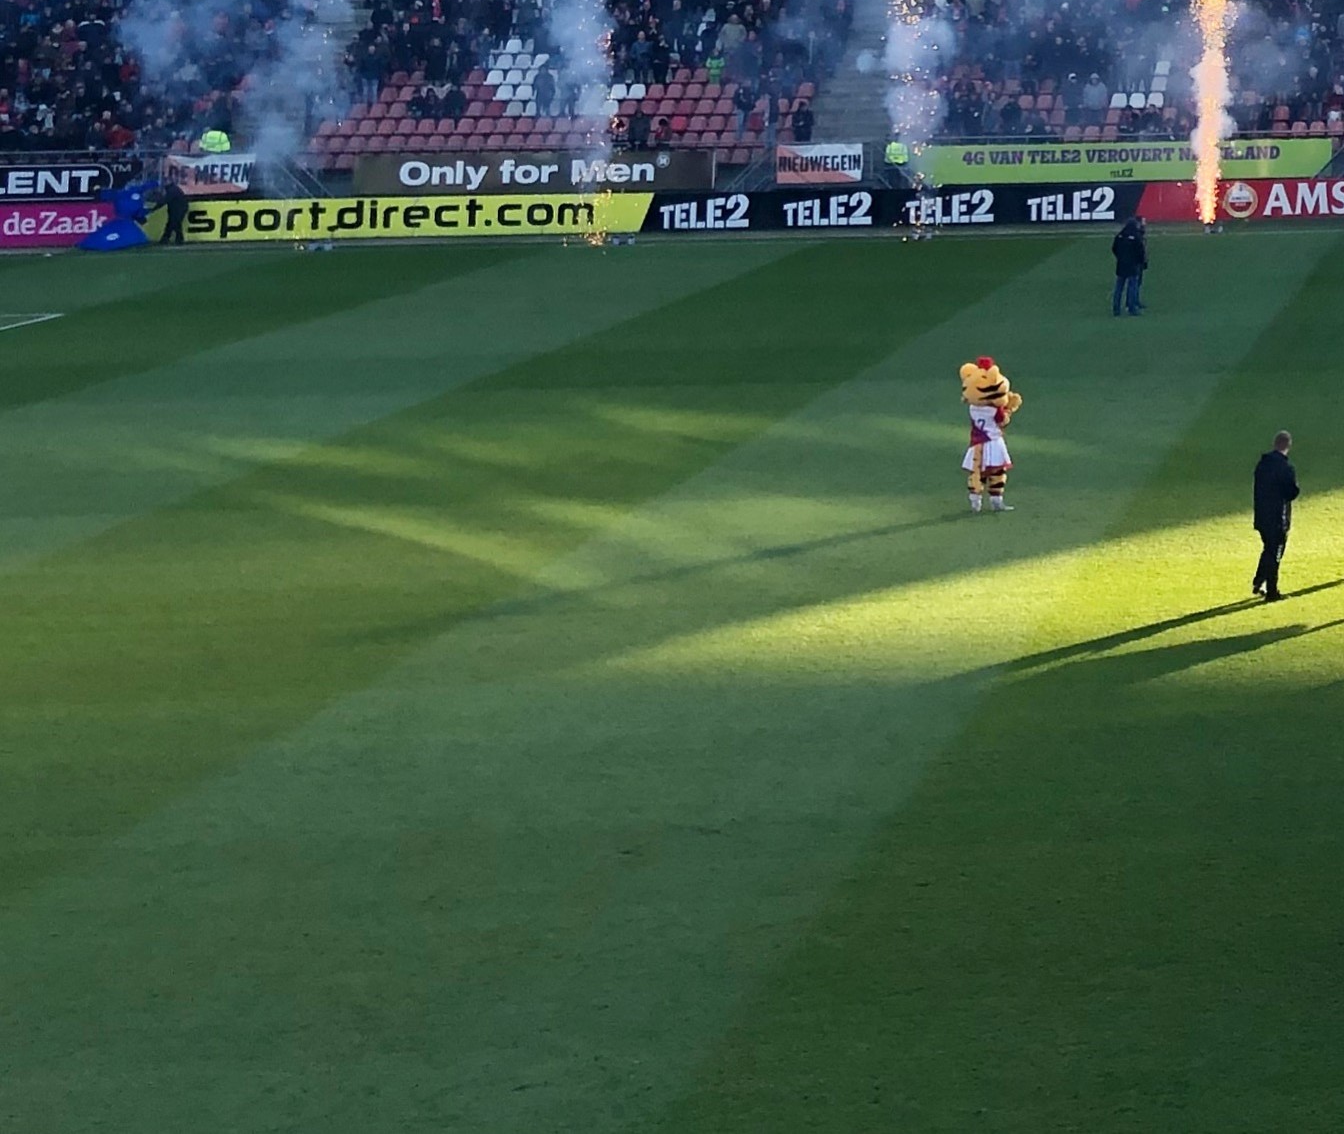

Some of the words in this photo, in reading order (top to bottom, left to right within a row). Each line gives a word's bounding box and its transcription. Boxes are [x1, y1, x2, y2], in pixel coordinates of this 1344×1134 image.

[778, 153, 862, 173] NIEUWEGEIN
[962, 151, 985, 166] 4G
[989, 150, 1024, 165] VAN
[1027, 149, 1081, 164] TELE2
[1085, 147, 1175, 164] VEROVERT
[0, 170, 100, 195] ENT
[194, 162, 255, 185] MEERN
[399, 160, 489, 191] Only
[499, 159, 559, 184] for
[571, 159, 655, 185] Men
[659, 193, 750, 230] TELE2
[783, 191, 873, 227] TELE2
[906, 188, 994, 225] TELE2
[1027, 186, 1115, 222] TELE2
[3, 212, 36, 236] de
[38, 209, 108, 235] Zaak
